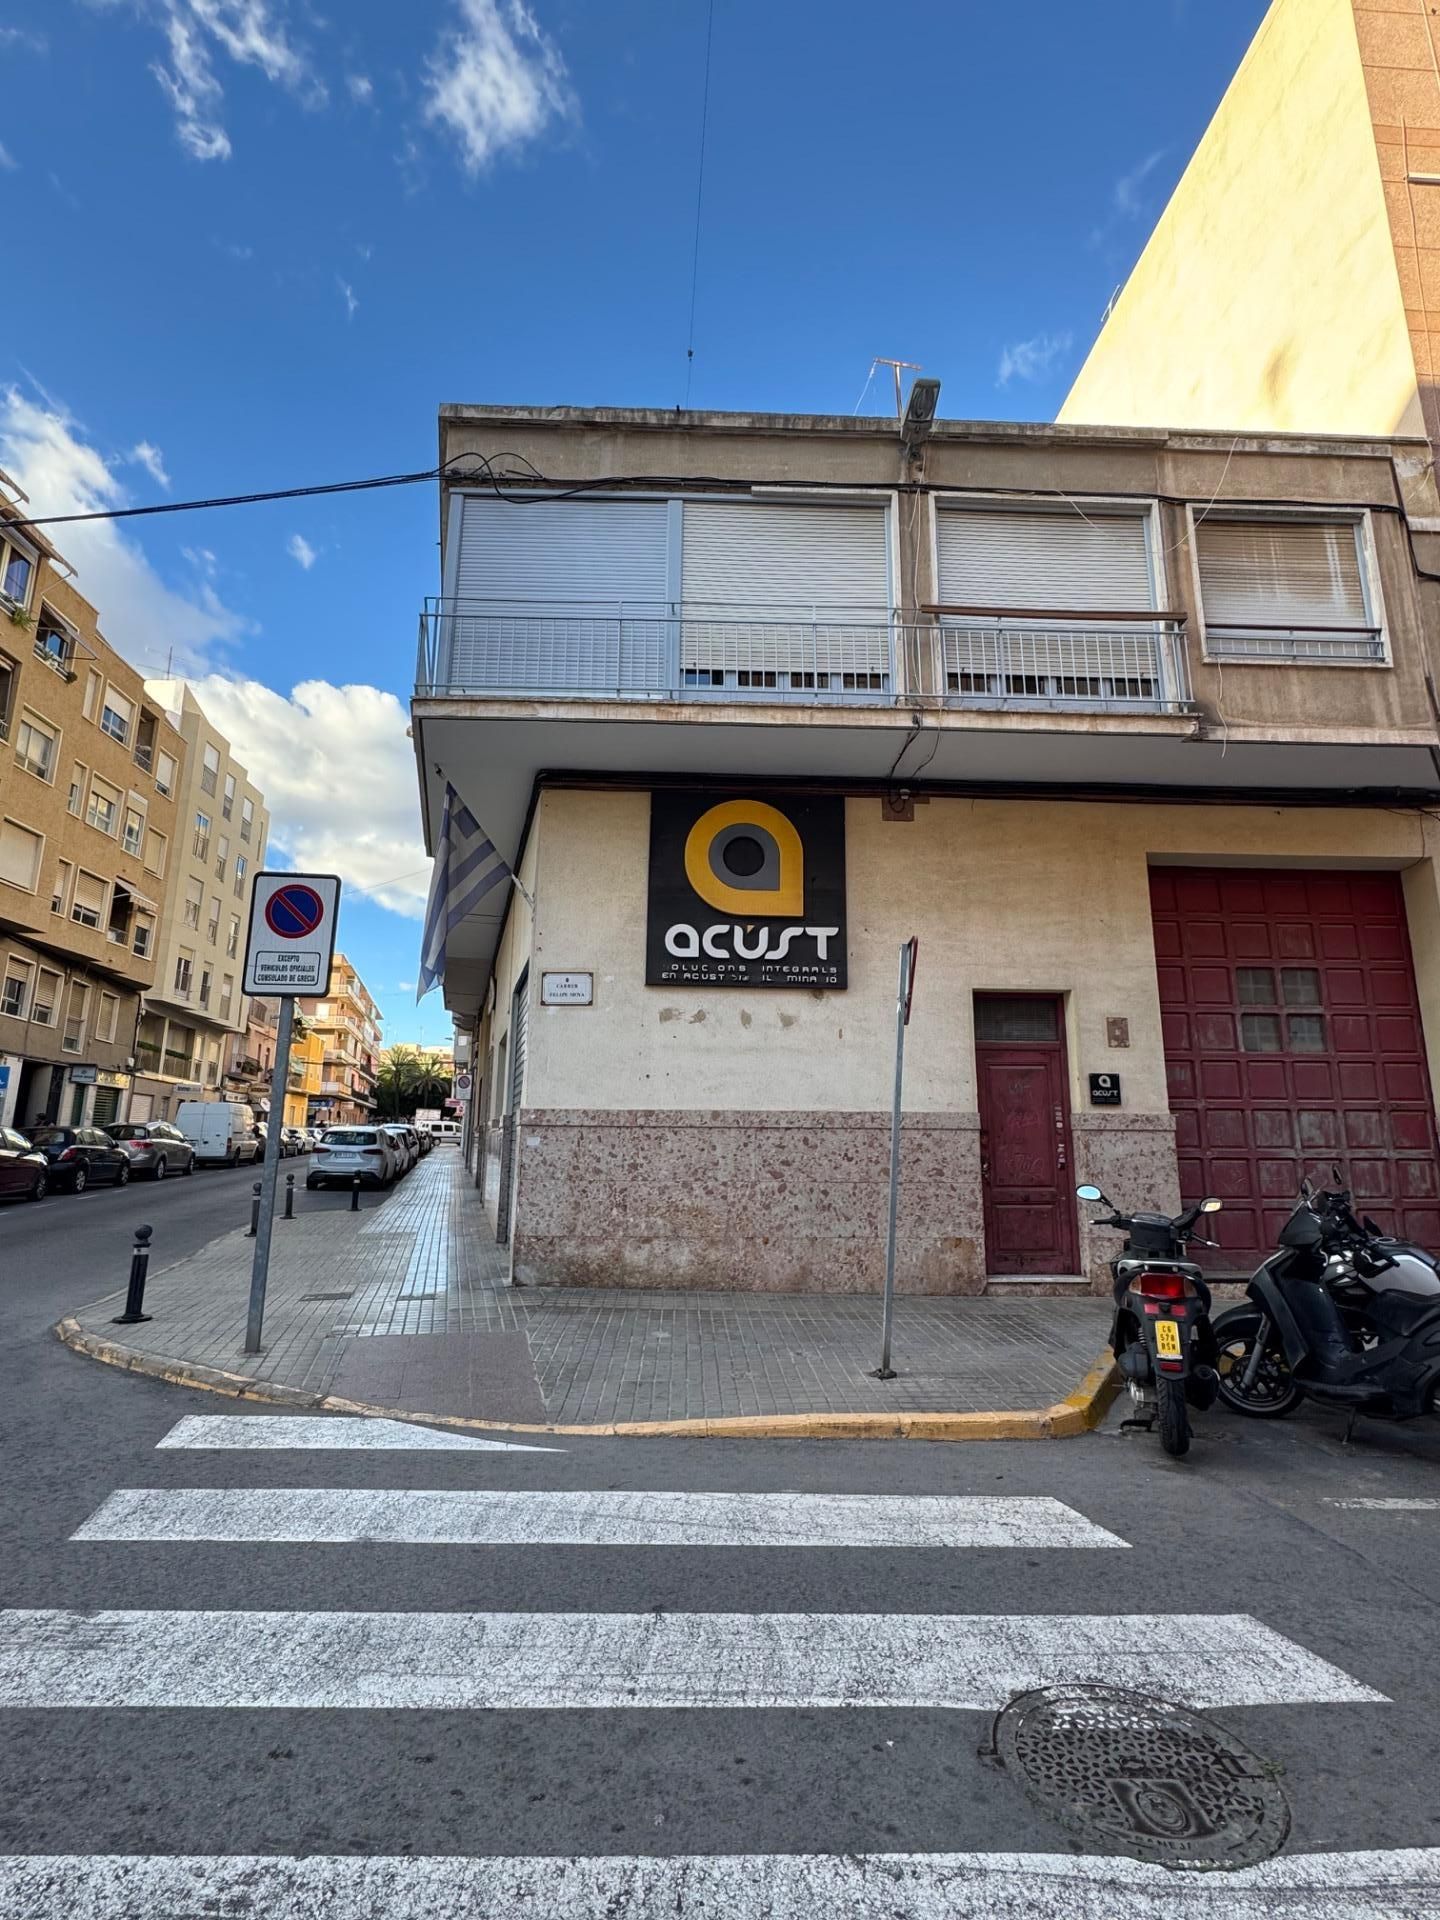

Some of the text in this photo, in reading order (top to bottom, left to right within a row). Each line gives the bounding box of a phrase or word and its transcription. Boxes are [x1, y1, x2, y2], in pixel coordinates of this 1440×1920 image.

[277, 954, 300, 963] EXCEPTO
[288, 964, 316, 973] OFICIALES
[762, 965, 838, 974] INTEGRALS
[257, 973, 316, 983] CONSULADO DE GRECIA
[661, 971, 677, 980] EN
